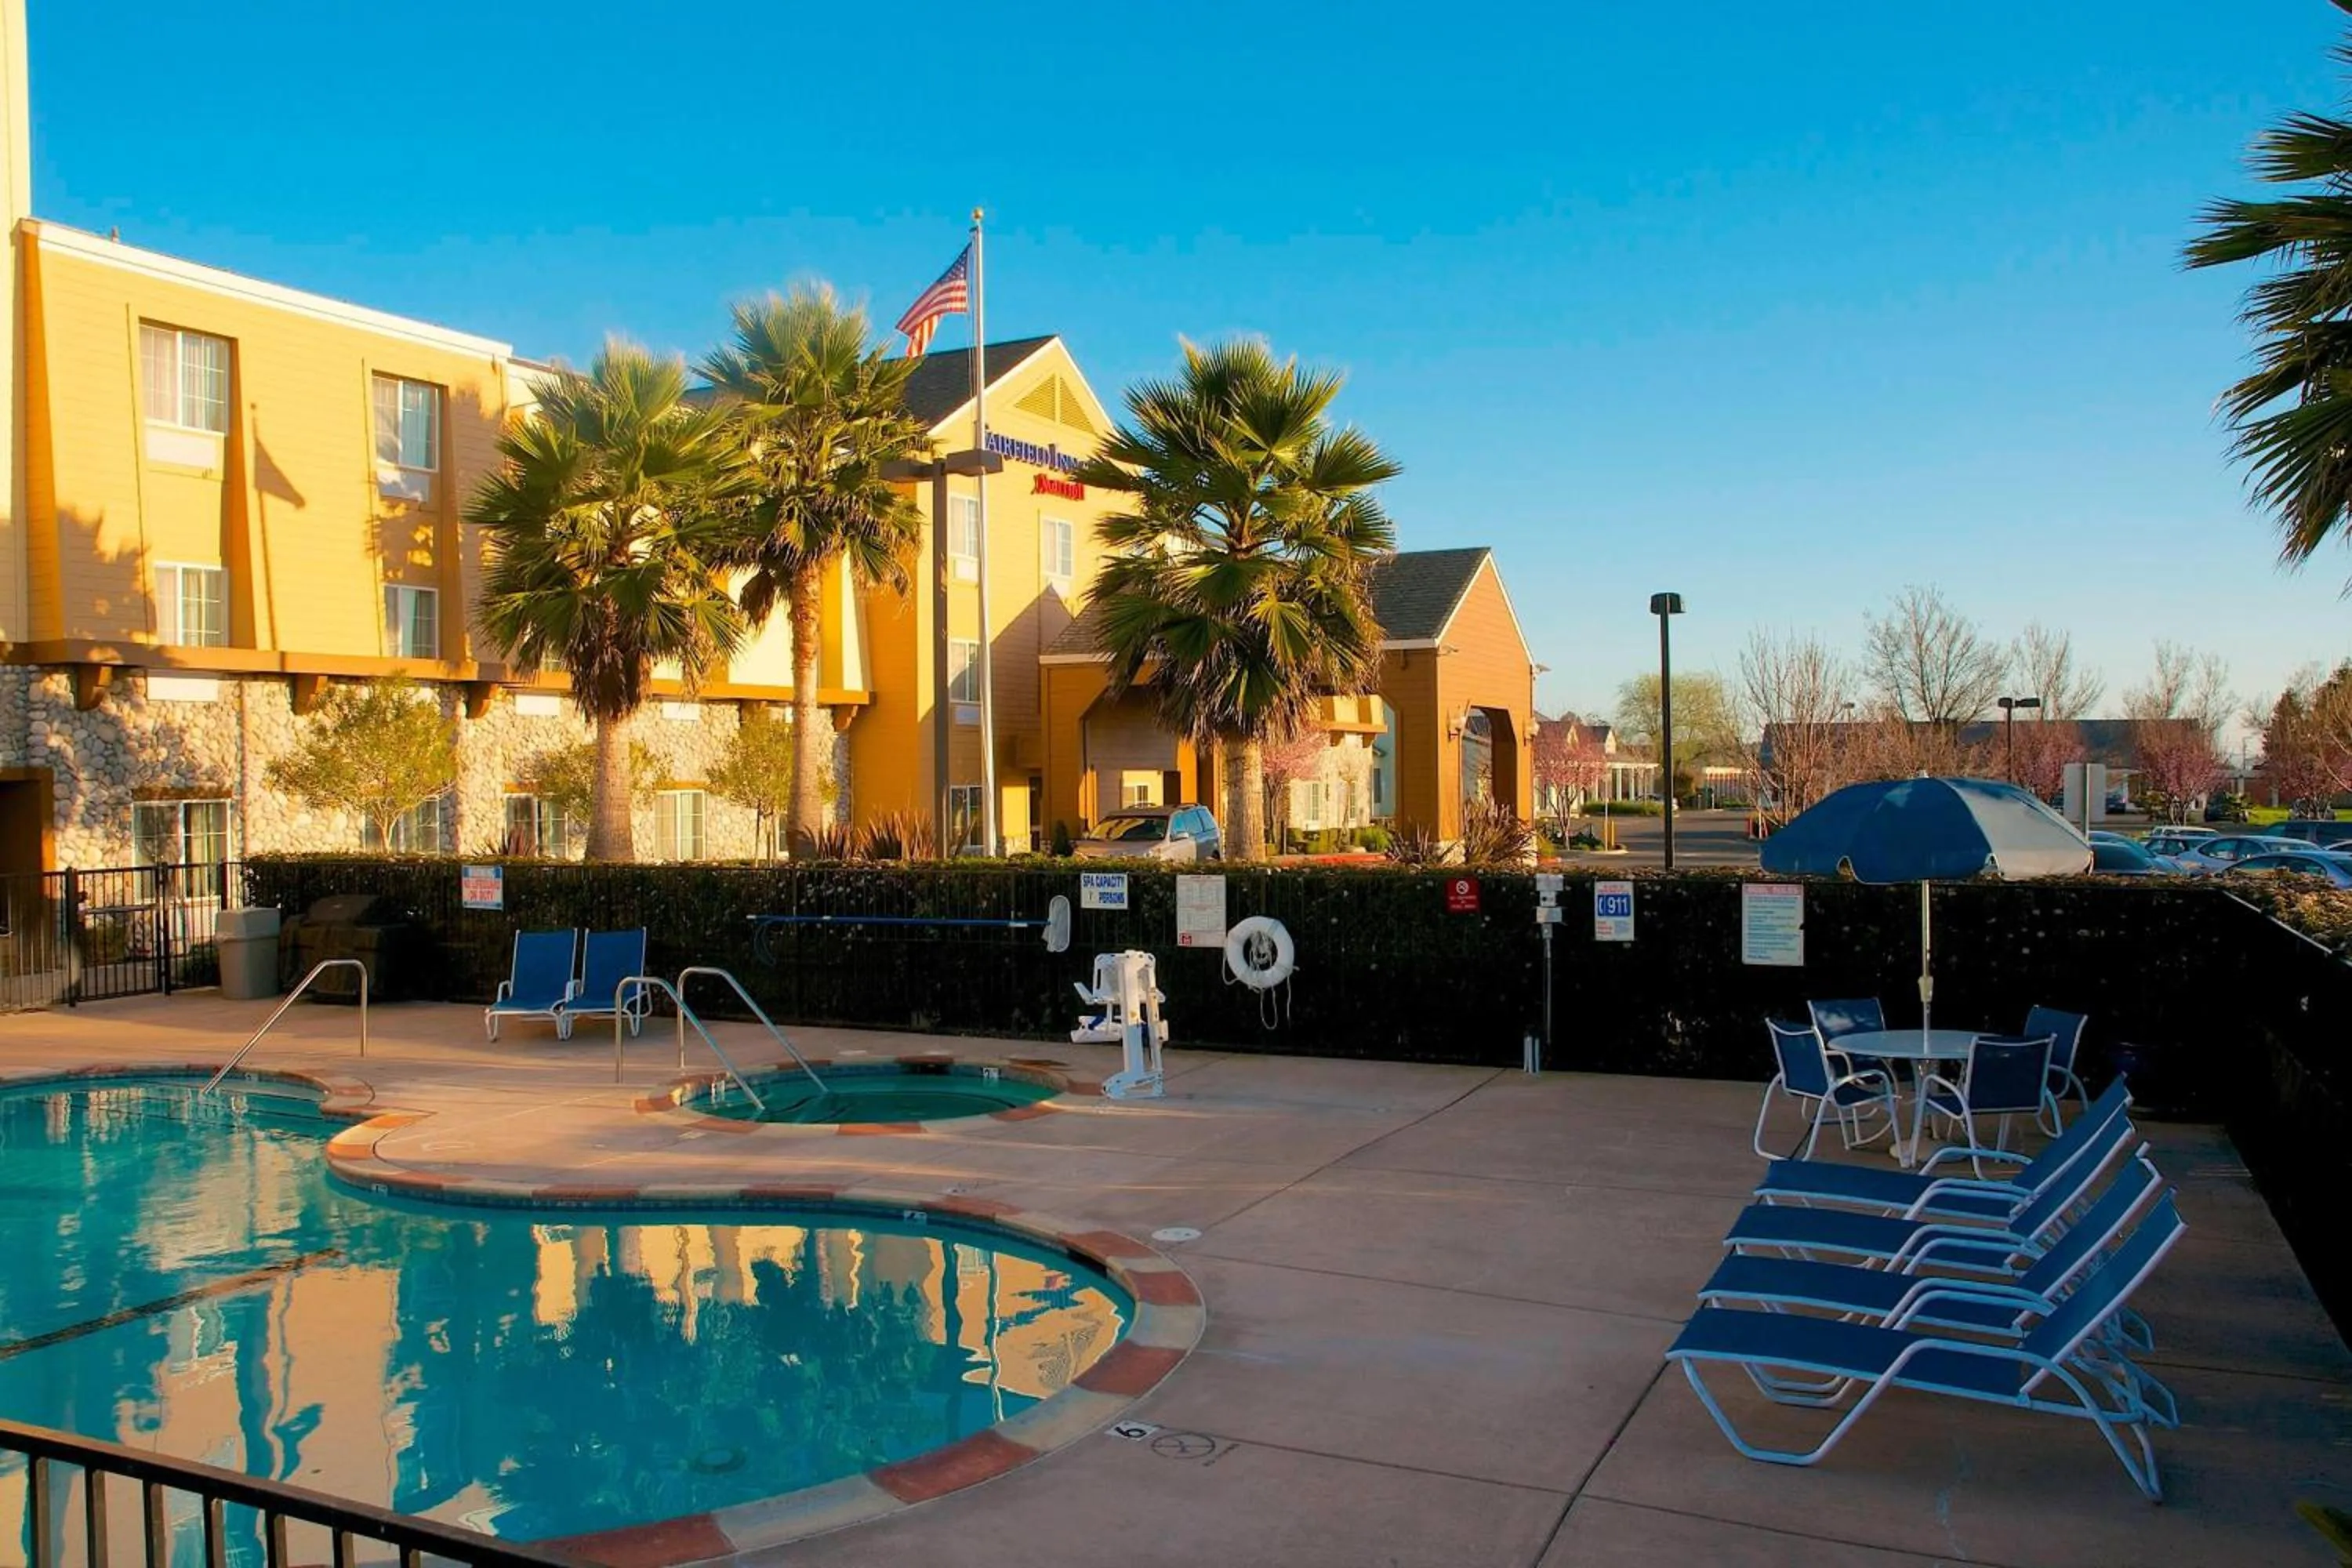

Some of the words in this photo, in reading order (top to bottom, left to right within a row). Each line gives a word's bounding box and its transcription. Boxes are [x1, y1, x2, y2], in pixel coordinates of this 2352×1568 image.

[985, 426, 1052, 466] AIRFIELD
[1083, 875, 1094, 887] SPA
[1096, 875, 1124, 888] CAPACITY
[1098, 891, 1124, 903] PERSONS
[1607, 896, 1628, 914] 911
[1114, 1426, 1147, 1438] 6
